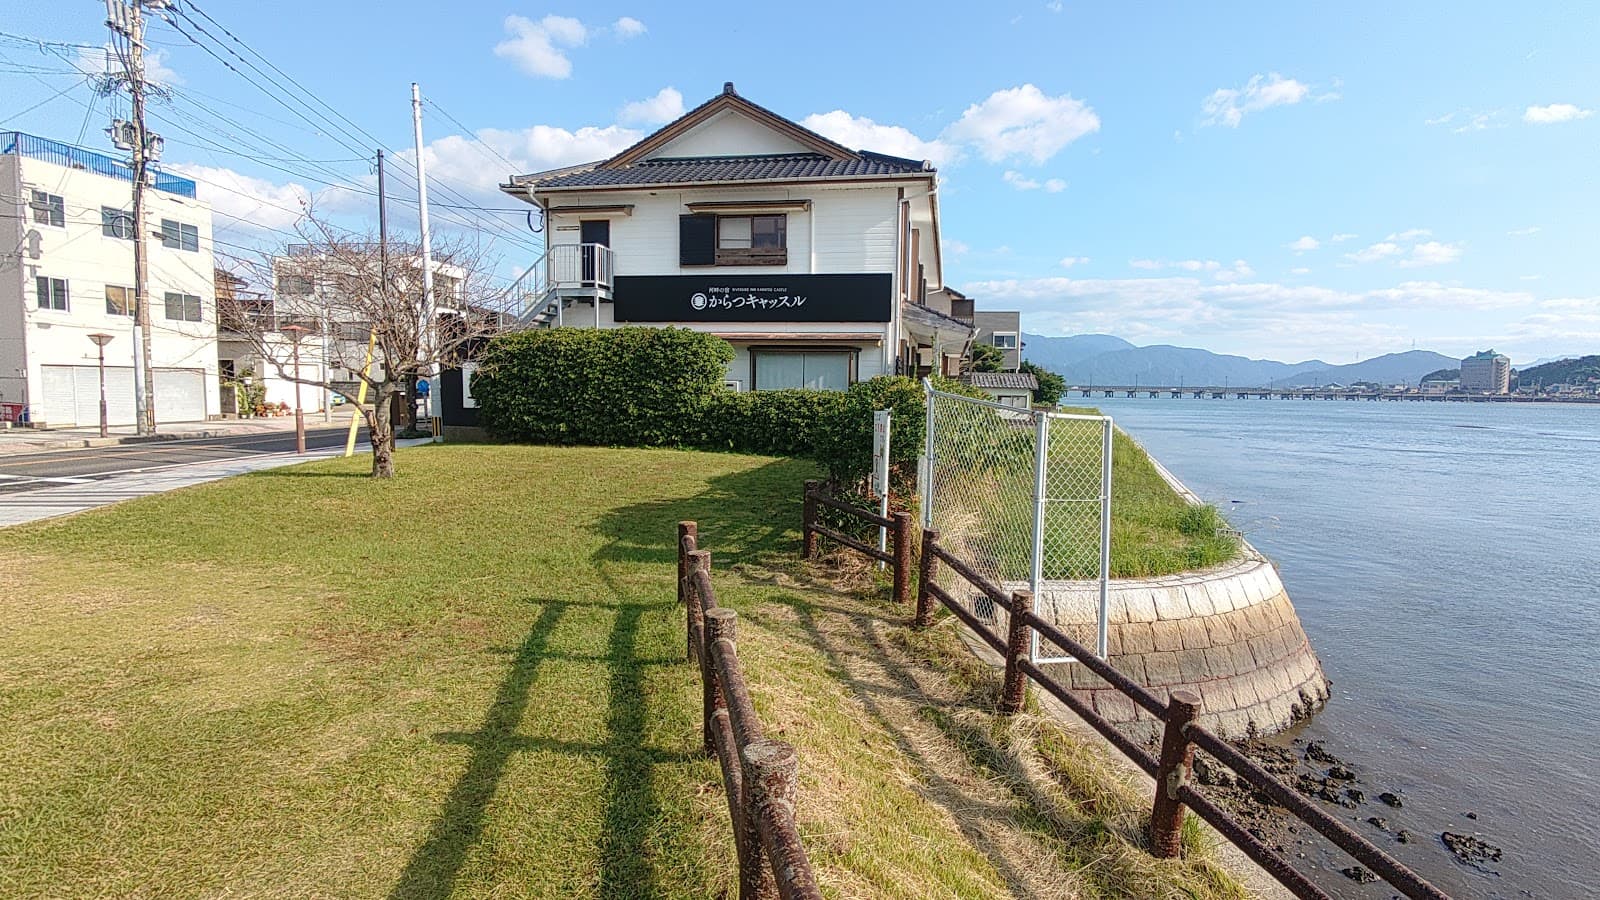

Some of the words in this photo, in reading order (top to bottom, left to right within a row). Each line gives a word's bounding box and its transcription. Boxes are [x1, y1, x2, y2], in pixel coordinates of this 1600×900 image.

[709, 294, 807, 309] からつキャッスル
